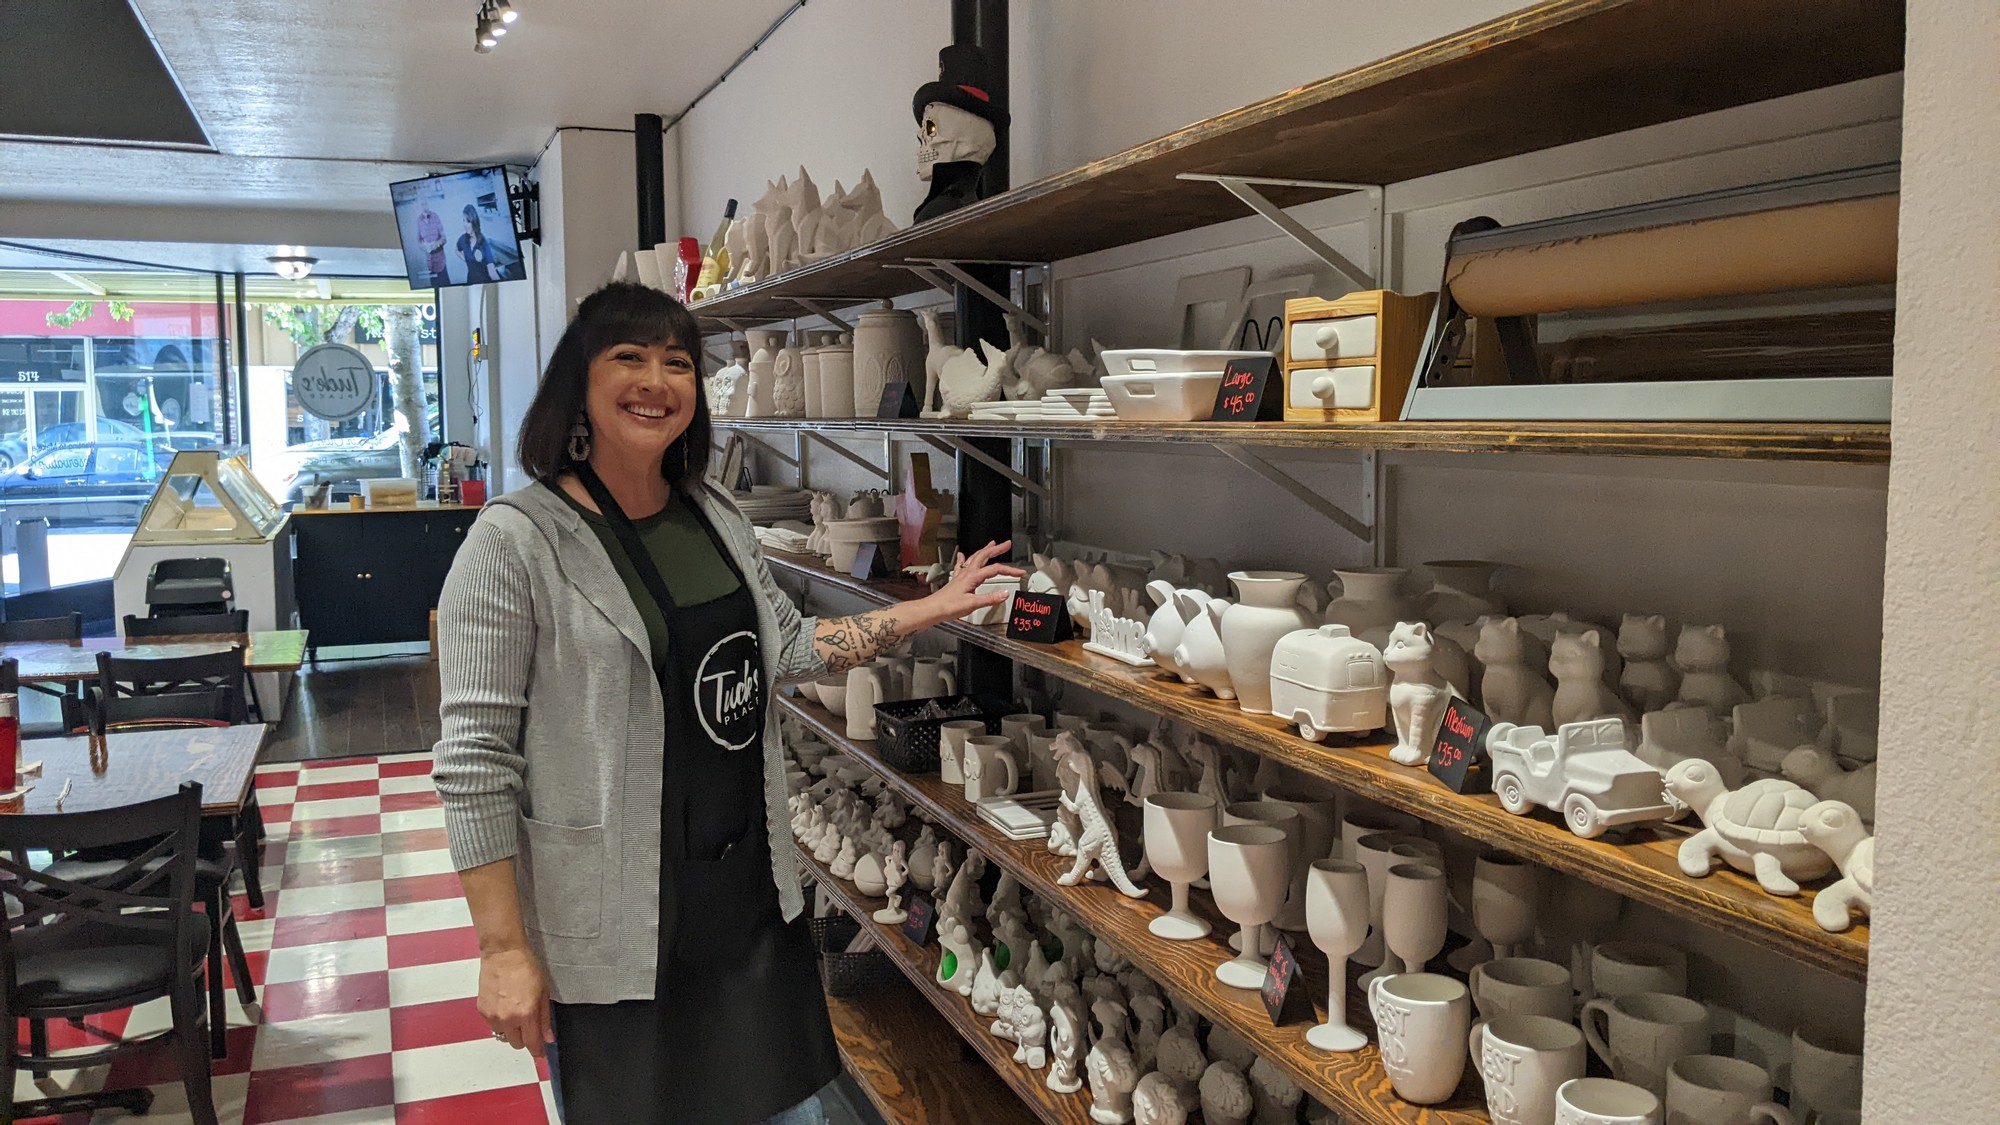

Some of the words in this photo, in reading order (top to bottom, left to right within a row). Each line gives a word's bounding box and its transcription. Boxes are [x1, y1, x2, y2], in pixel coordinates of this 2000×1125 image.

[18, 371, 39, 382] 514
[1224, 365, 1254, 389] Large
[1223, 392, 1255, 415] $45.00
[1015, 597, 1051, 615] Medium
[1013, 617, 1041, 631] $35.00
[1444, 706, 1474, 743] Medium
[1376, 998, 1411, 1038] EST
[1482, 1042, 1522, 1087] EST
